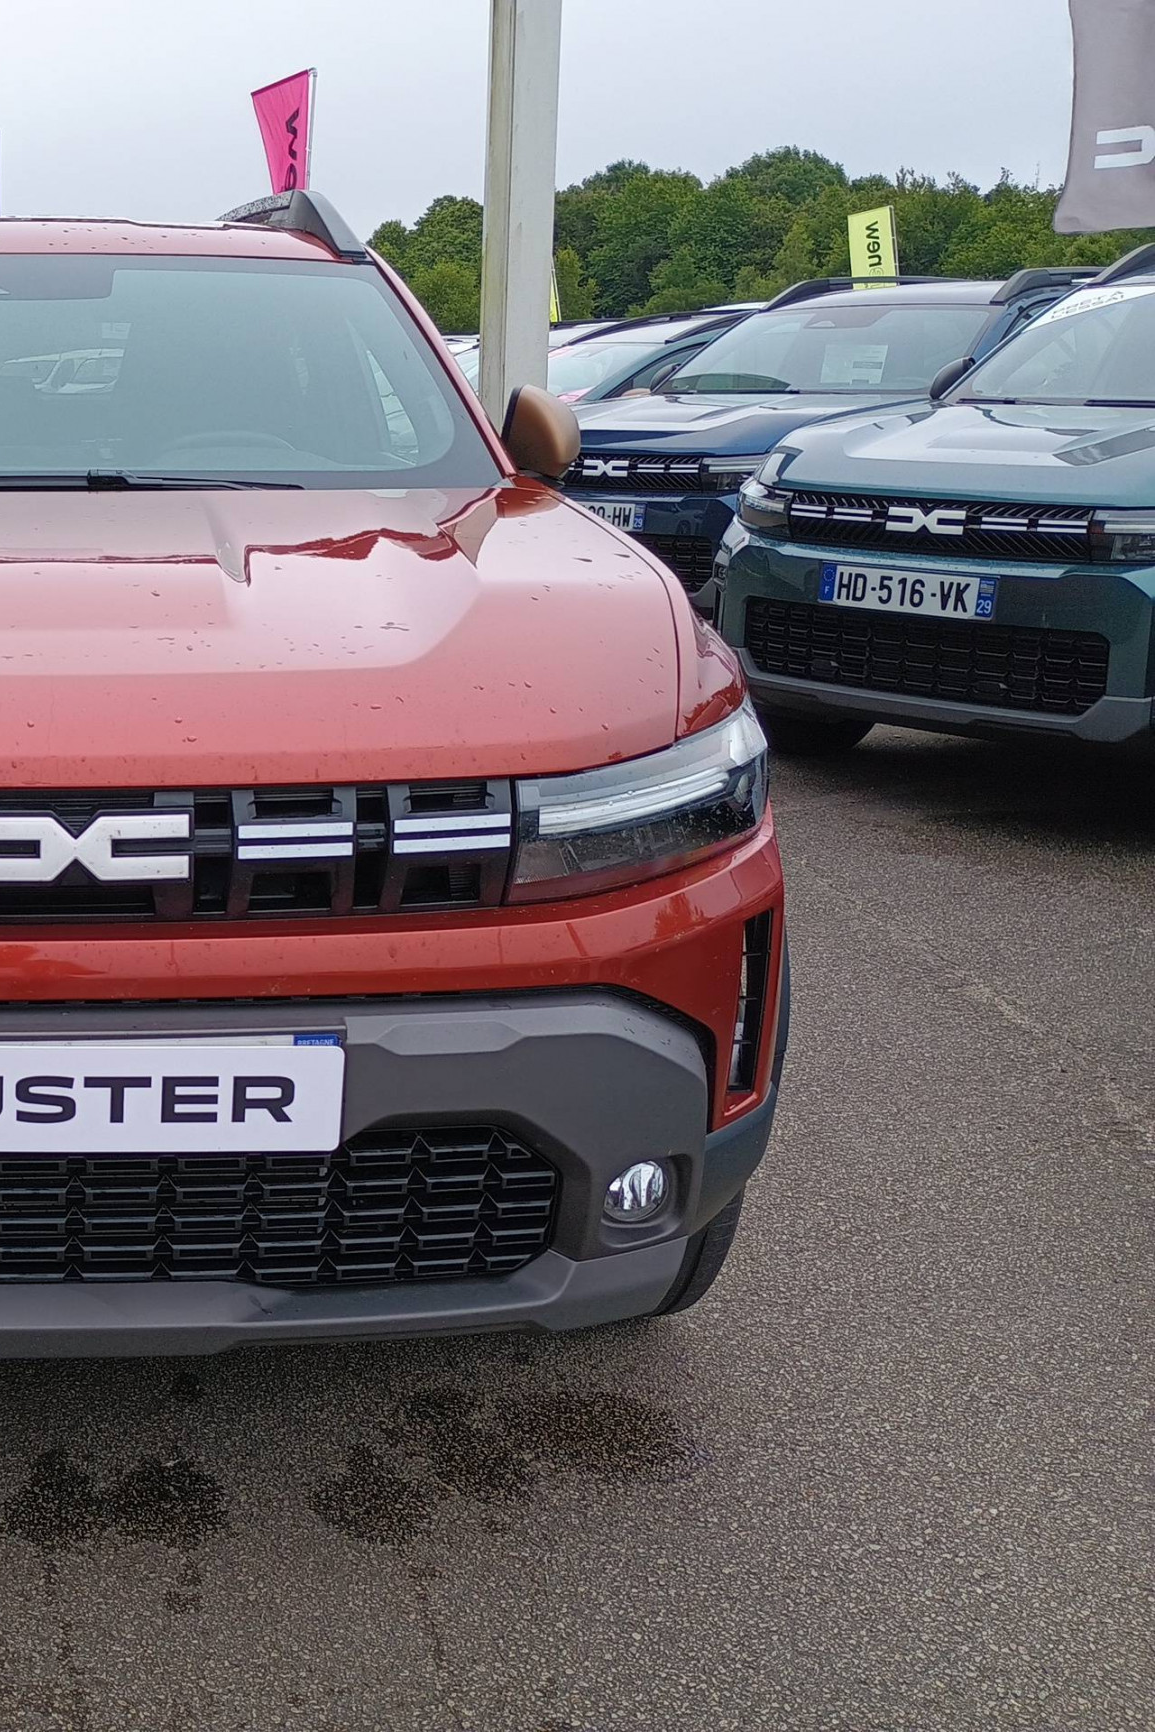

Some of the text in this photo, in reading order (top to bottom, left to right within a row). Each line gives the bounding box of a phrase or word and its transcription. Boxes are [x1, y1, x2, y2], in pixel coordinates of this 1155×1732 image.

[824, 571, 993, 614] F HD-516-VK 29
